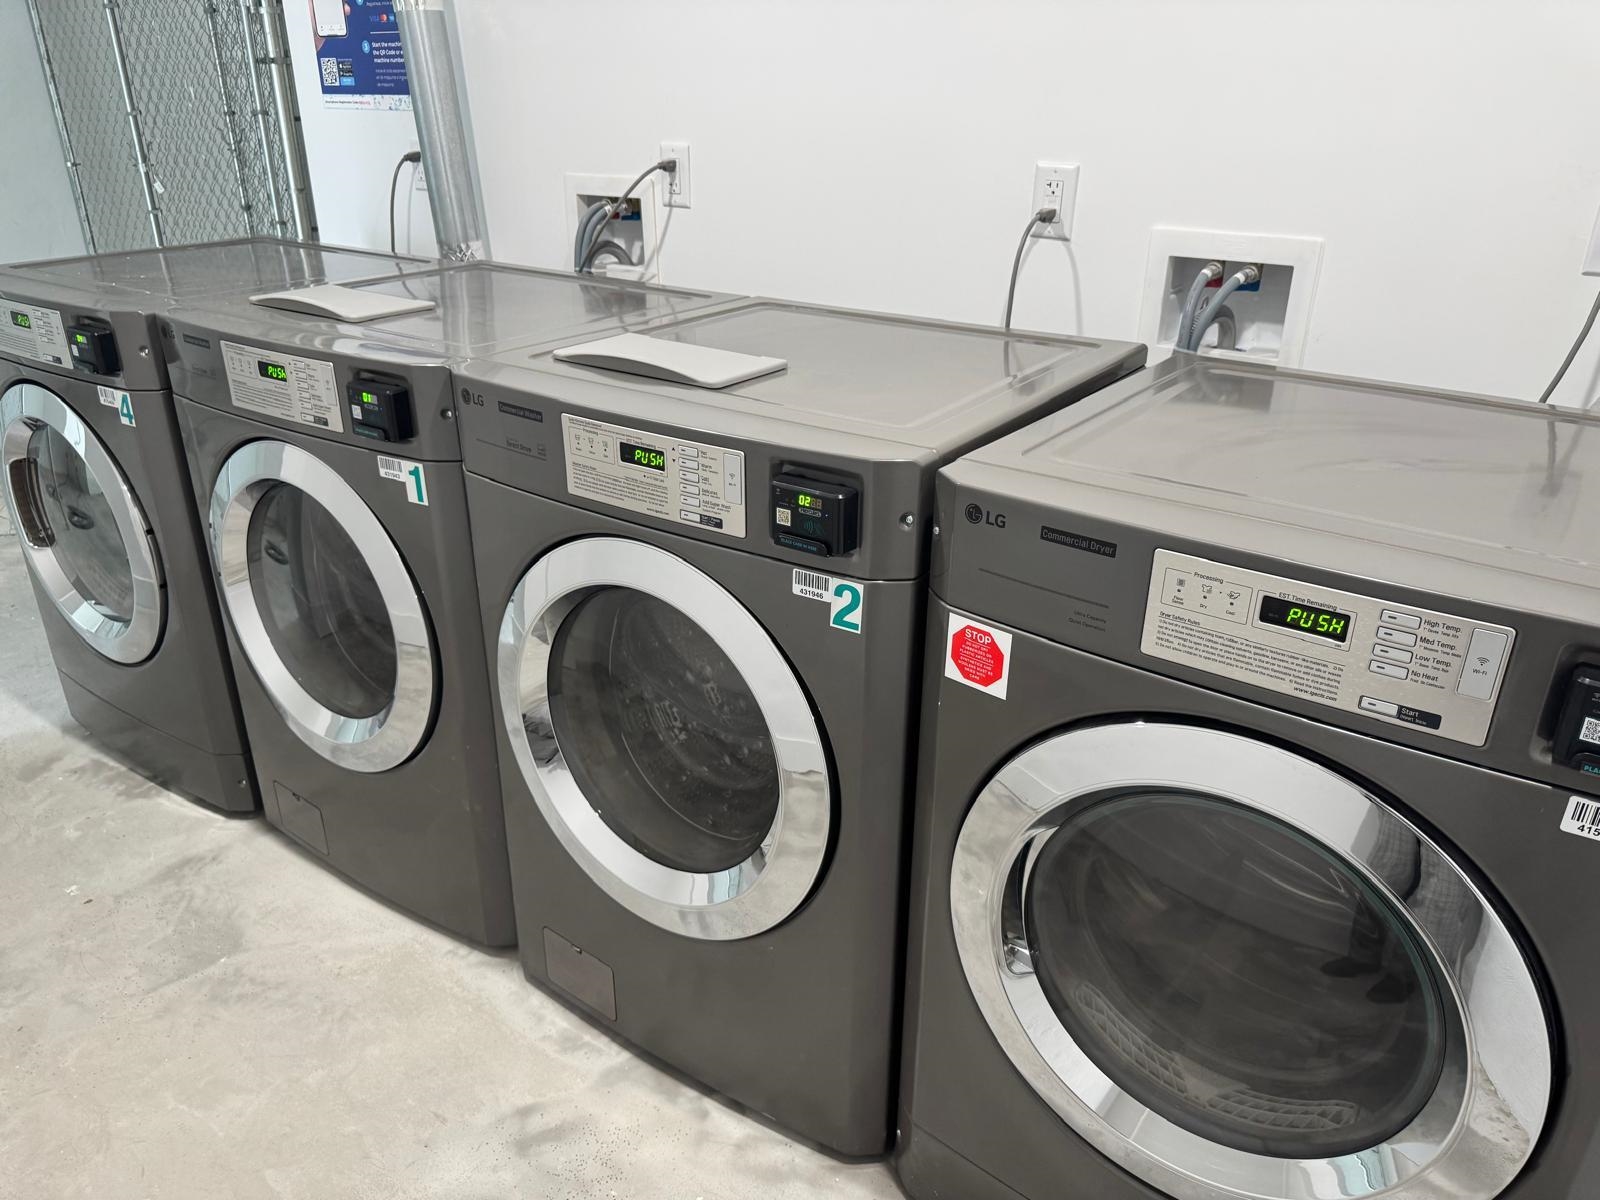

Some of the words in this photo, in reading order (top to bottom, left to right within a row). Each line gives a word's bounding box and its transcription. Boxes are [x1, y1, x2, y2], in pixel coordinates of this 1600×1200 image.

[472, 392, 484, 407] LG
[120, 394, 134, 424] 4
[635, 449, 664, 466] PUSH
[408, 465, 424, 503] 1
[799, 494, 810, 506] 02
[986, 510, 1006, 528] LG
[1042, 529, 1089, 549] Commercial
[1090, 538, 1114, 554] Dryer
[1194, 572, 1224, 584] Processing
[800, 588, 824, 599] 431946
[832, 583, 861, 632] 2
[1307, 598, 1338, 611] Remaining
[1287, 608, 1345, 634] PUSH
[1424, 619, 1440, 628] High
[965, 628, 992, 645] STOP
[1420, 636, 1435, 645] Med
[1415, 654, 1430, 662] Low
[1422, 673, 1438, 682] Heat
[1401, 708, 1419, 717] Start
[1584, 765, 1600, 775] PLA
